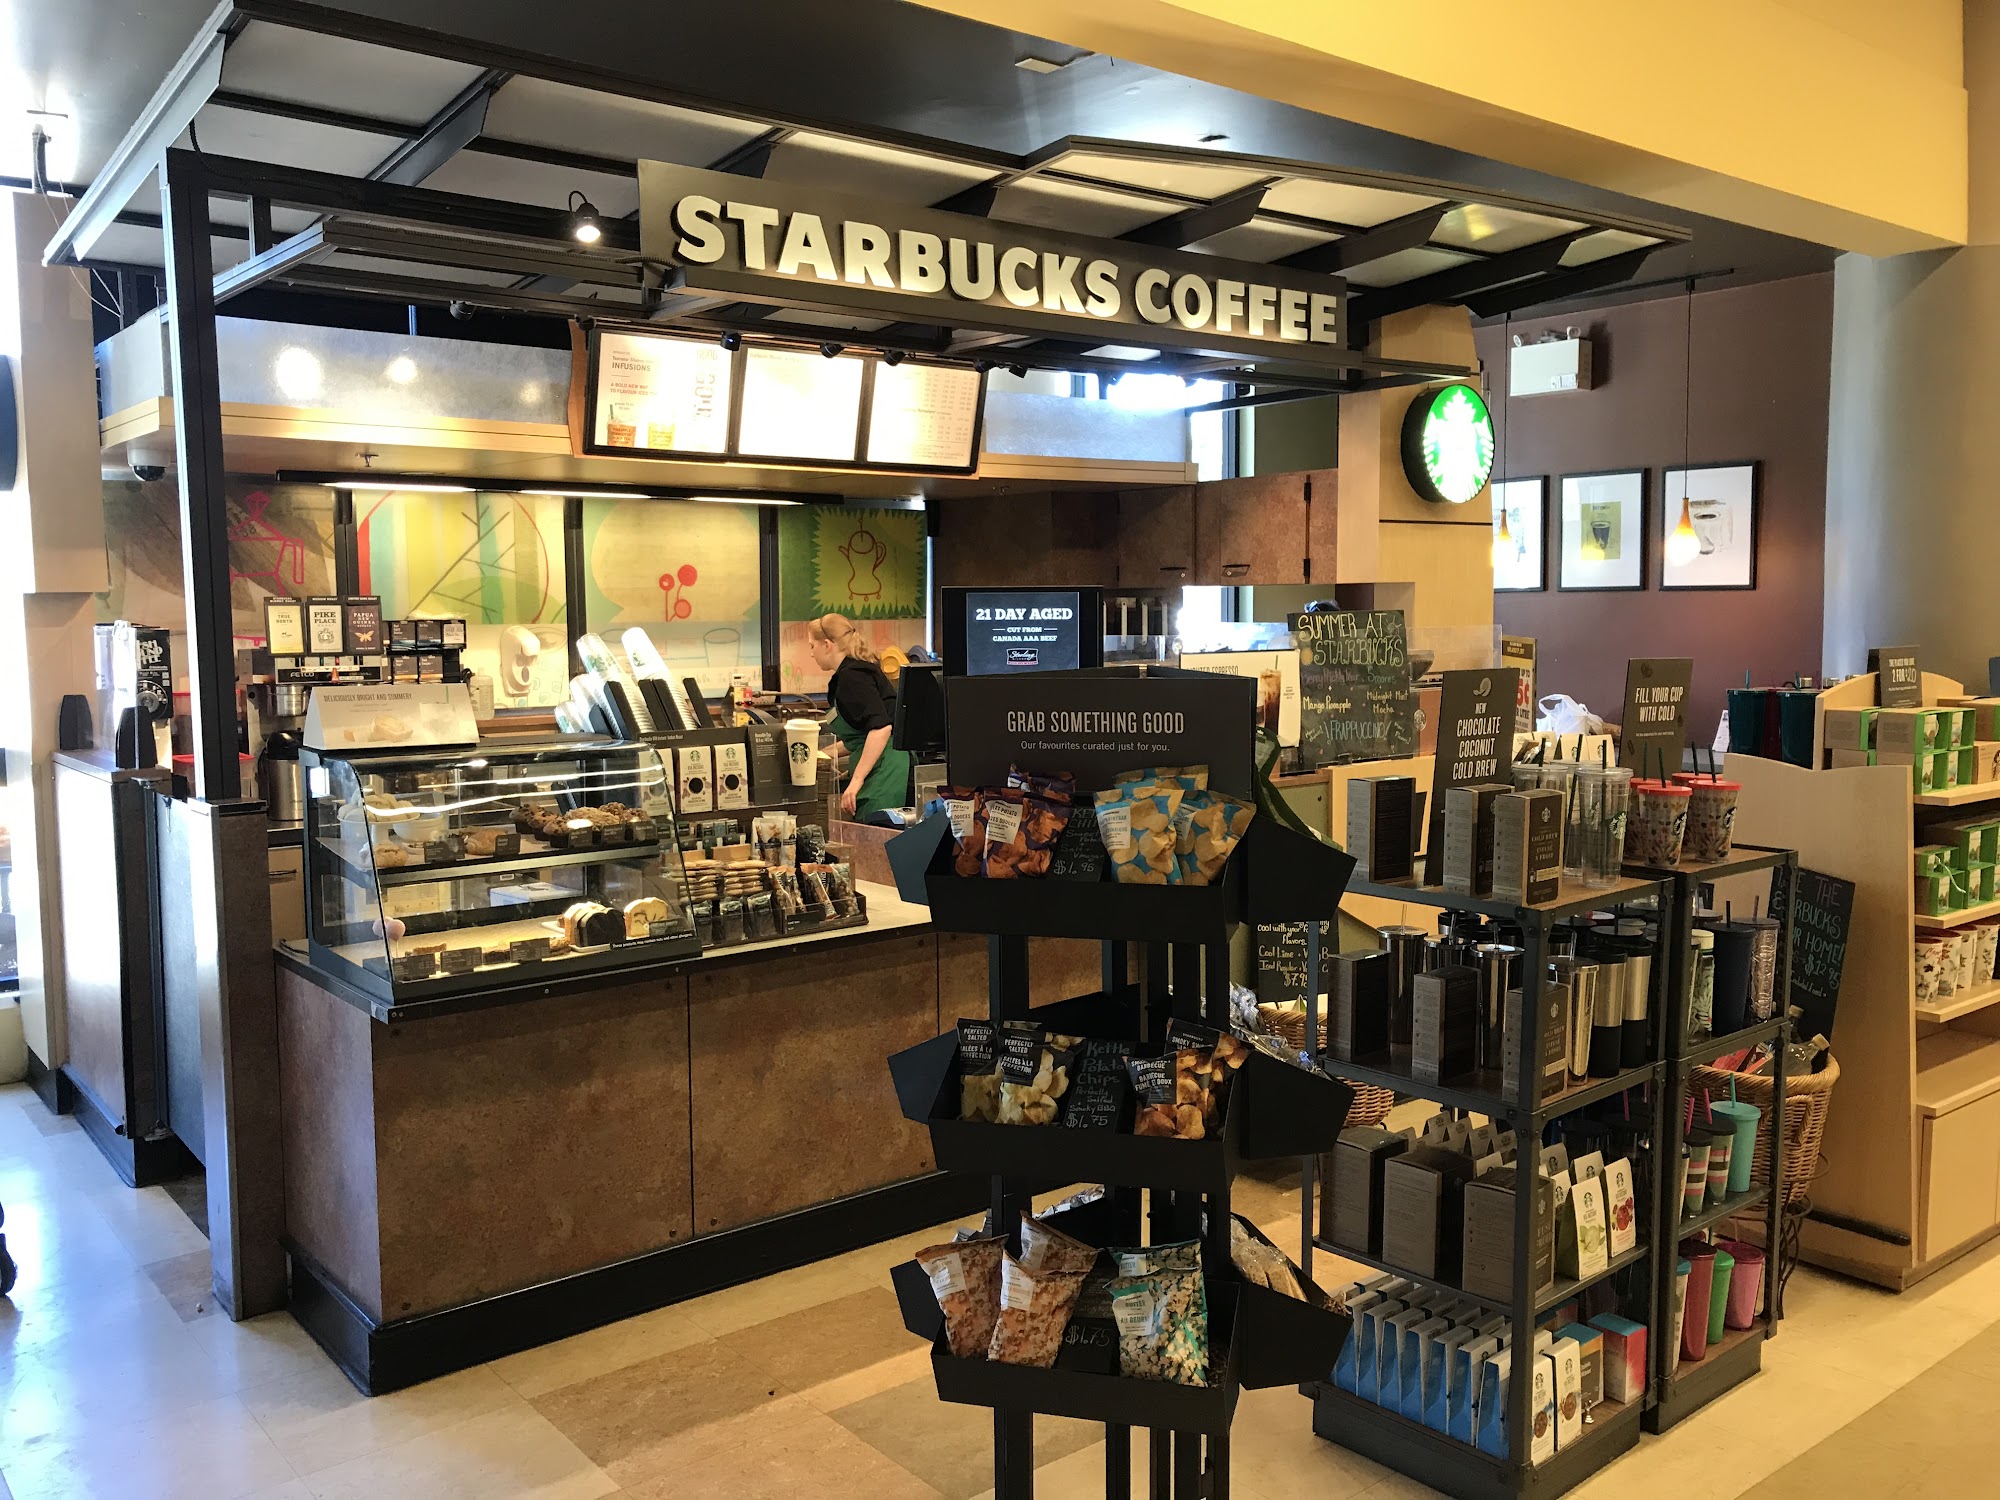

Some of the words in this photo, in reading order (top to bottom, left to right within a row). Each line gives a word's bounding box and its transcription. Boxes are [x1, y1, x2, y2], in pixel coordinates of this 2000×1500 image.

[677, 194, 1120, 318] STARBUCKS
[1134, 267, 1339, 345] COFFEE
[612, 361, 651, 372] INFUSIONS
[976, 608, 992, 621] 21
[994, 608, 1027, 620] DAY
[1029, 607, 1073, 620] AGED
[1297, 612, 1357, 641] SUMMER
[1364, 612, 1387, 638] AT
[1313, 637, 1404, 667] STARBUCKS
[1896, 668, 1905, 682] FOR
[323, 694, 356, 702] DELICIOUSLY
[376, 693, 387, 701] AND
[387, 692, 412, 701] SUMMERY
[1366, 690, 1393, 704] Midnight
[1395, 690, 1409, 701] Mint
[1635, 687, 1650, 704] FILL
[1651, 686, 1669, 703] YOUR
[1669, 686, 1684, 703] CUP
[1302, 696, 1325, 714] Mango
[1325, 695, 1352, 714] Pineapple
[1372, 704, 1395, 714] Mocha
[1475, 702, 1487, 715] NEW
[1639, 705, 1657, 723] WITH
[1657, 705, 1675, 722] COLD
[1007, 710, 1045, 733] GRAB
[1050, 711, 1137, 734] SOMETHING
[1142, 711, 1185, 735] GOOD
[1456, 716, 1501, 738] CHOCOLATE
[1020, 740, 1036, 750] Our
[1038, 740, 1080, 750] favourites
[1082, 740, 1115, 751] curated
[1117, 741, 1135, 752] just
[1136, 741, 1150, 751] for
[1151, 743, 1170, 753] you.
[1458, 737, 1496, 759] COCONUT
[1452, 760, 1474, 781] COLD
[1474, 758, 1498, 778] BREW
[1072, 807, 1097, 819] KET
[1815, 875, 1843, 908] THE
[1257, 923, 1272, 932] Cool
[1272, 922, 1287, 932] with
[1287, 927, 1301, 937] your
[1258, 945, 1275, 957] Cool
[1277, 946, 1294, 958] Lime
[1805, 931, 1845, 967] HOME!
[960, 1044, 978, 1052] ALÉES
[1004, 1038, 1034, 1048] PERFECTLY
[1171, 1036, 1190, 1046] SMOKY
[1008, 1046, 1028, 1054] SALTED
[1086, 1040, 1130, 1057] Kettle
[1026, 1059, 1034, 1067] LA
[1081, 1057, 1125, 1073] Potato
[1136, 1061, 1166, 1072] BARBECUE
[1076, 1072, 1121, 1086] Chips
[1138, 1072, 1166, 1083] BARBECUE
[1075, 1085, 1109, 1098] Perfectly
[1086, 1094, 1113, 1104] Salted
[1069, 1103, 1096, 1114] Smoky
[1097, 1104, 1116, 1112] BBQ
[1066, 1112, 1108, 1128] $1.75
[1065, 1324, 1112, 1347] $1.75
